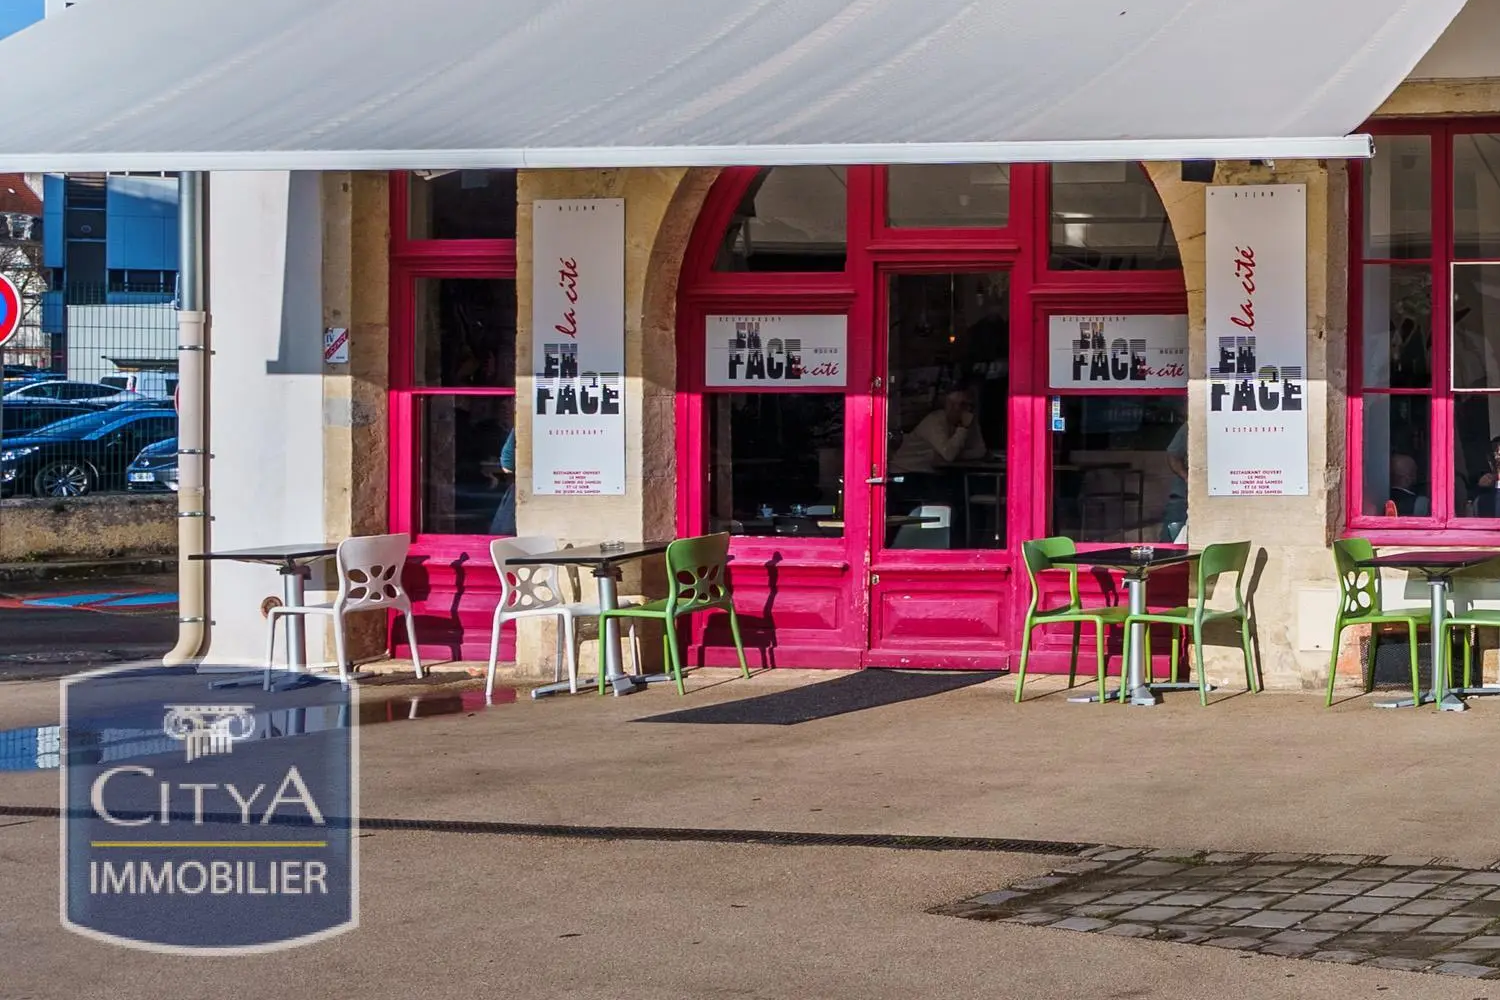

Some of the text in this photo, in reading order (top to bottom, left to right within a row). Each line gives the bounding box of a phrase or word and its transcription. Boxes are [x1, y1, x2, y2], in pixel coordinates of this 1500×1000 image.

[555, 257, 579, 339] la cité
[1230, 245, 1256, 331] la cité
[736, 322, 761, 349] EN
[1080, 322, 1107, 349] EN
[1218, 336, 1256, 373] EN
[543, 343, 578, 378] EN
[728, 338, 801, 379] FACE
[1072, 337, 1147, 380] FACE
[536, 371, 619, 414] FACE
[1210, 365, 1302, 411] FACE
